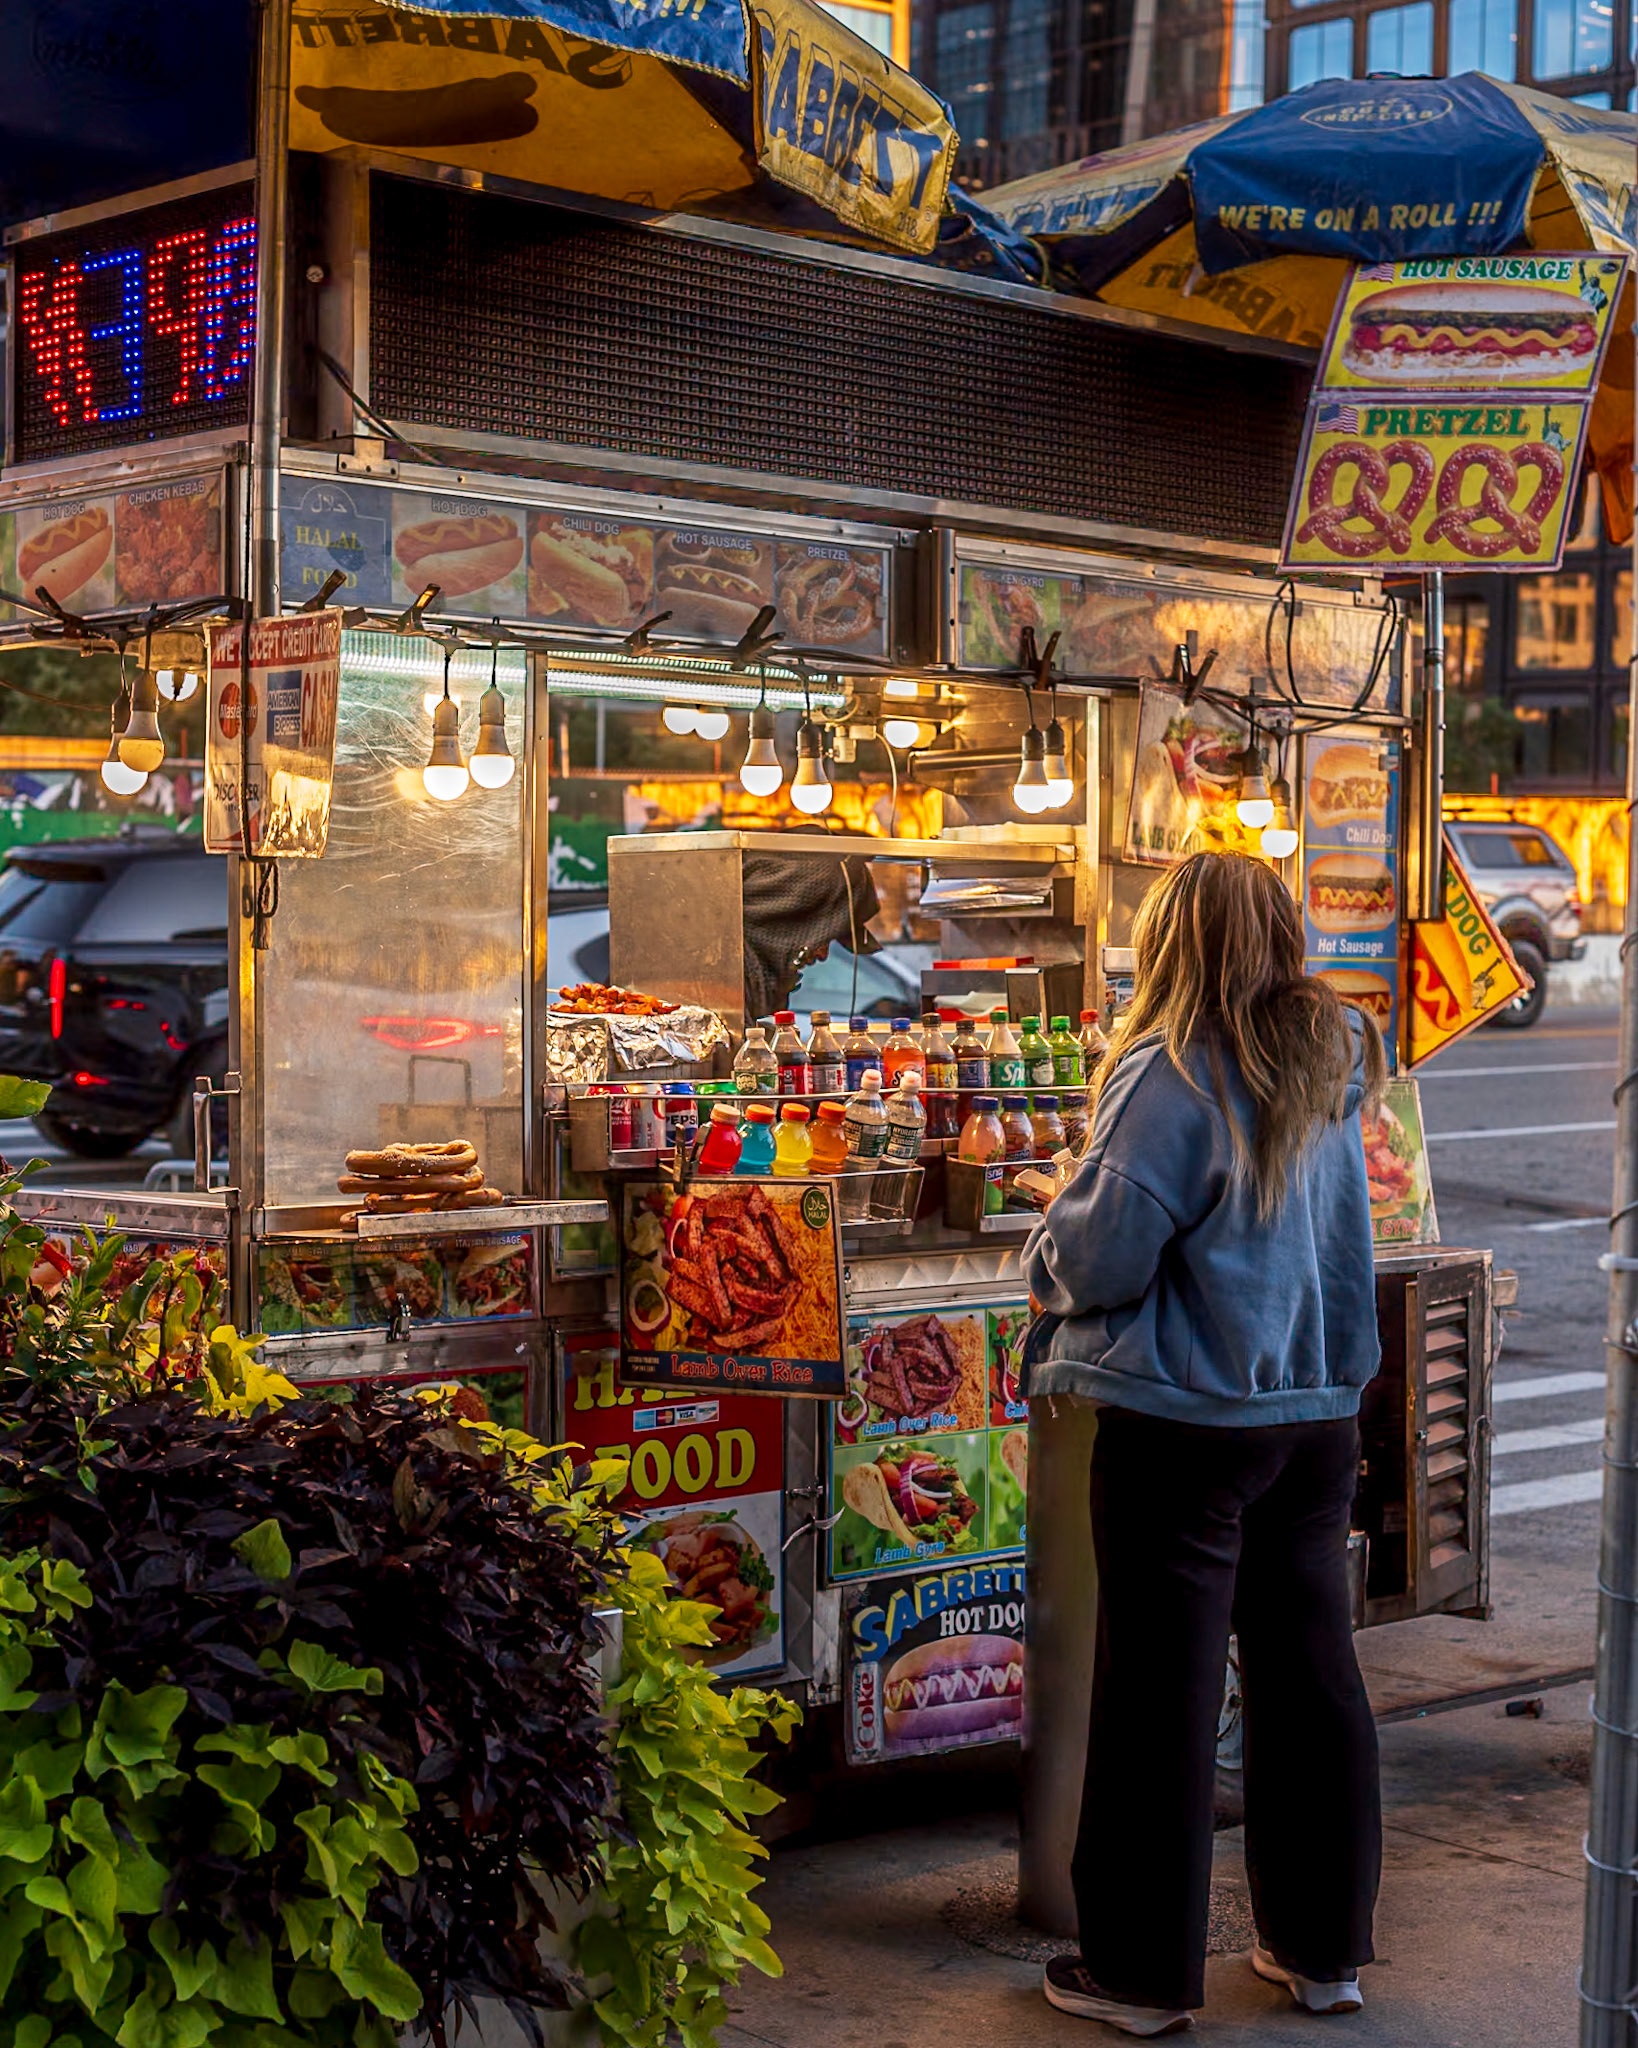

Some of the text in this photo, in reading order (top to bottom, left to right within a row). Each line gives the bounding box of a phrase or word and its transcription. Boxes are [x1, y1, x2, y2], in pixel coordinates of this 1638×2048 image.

[1218, 201, 1502, 231] WE'RE ON A ROLL !!!
[1401, 258, 1573, 282] HOT SAUSAGE
[1363, 408, 1530, 438] PRETZEL
[128, 480, 205, 506] CHICKEN KEBAB
[43, 502, 85, 521] HOT DOG
[431, 498, 488, 518] HOT DOG
[295, 525, 363, 550] HALAL
[562, 517, 620, 536] CHILI DOG
[676, 531, 752, 551] HOT SAUSAGE
[808, 546, 850, 562] PRETZEL
[302, 567, 357, 589] FOD
[1020, 576, 1044, 588] GYRO
[214, 634, 235, 662] WE
[238, 629, 280, 661] CCEPT
[281, 626, 313, 660] CREDIT
[302, 669, 338, 748] CASH
[1346, 826, 1393, 848] Chili Dog
[1447, 893, 1491, 956] DOG
[1317, 938, 1384, 958] Hot Sausage
[671, 1354, 719, 1380] Lamb
[723, 1357, 767, 1382] Over
[771, 1360, 814, 1384] Rice
[863, 1412, 958, 1436] Lamb Over Rice
[875, 1540, 946, 1565] Lamb Gyro
[940, 1602, 1026, 1637] HOT DO
[858, 1672, 875, 1749] Coke
